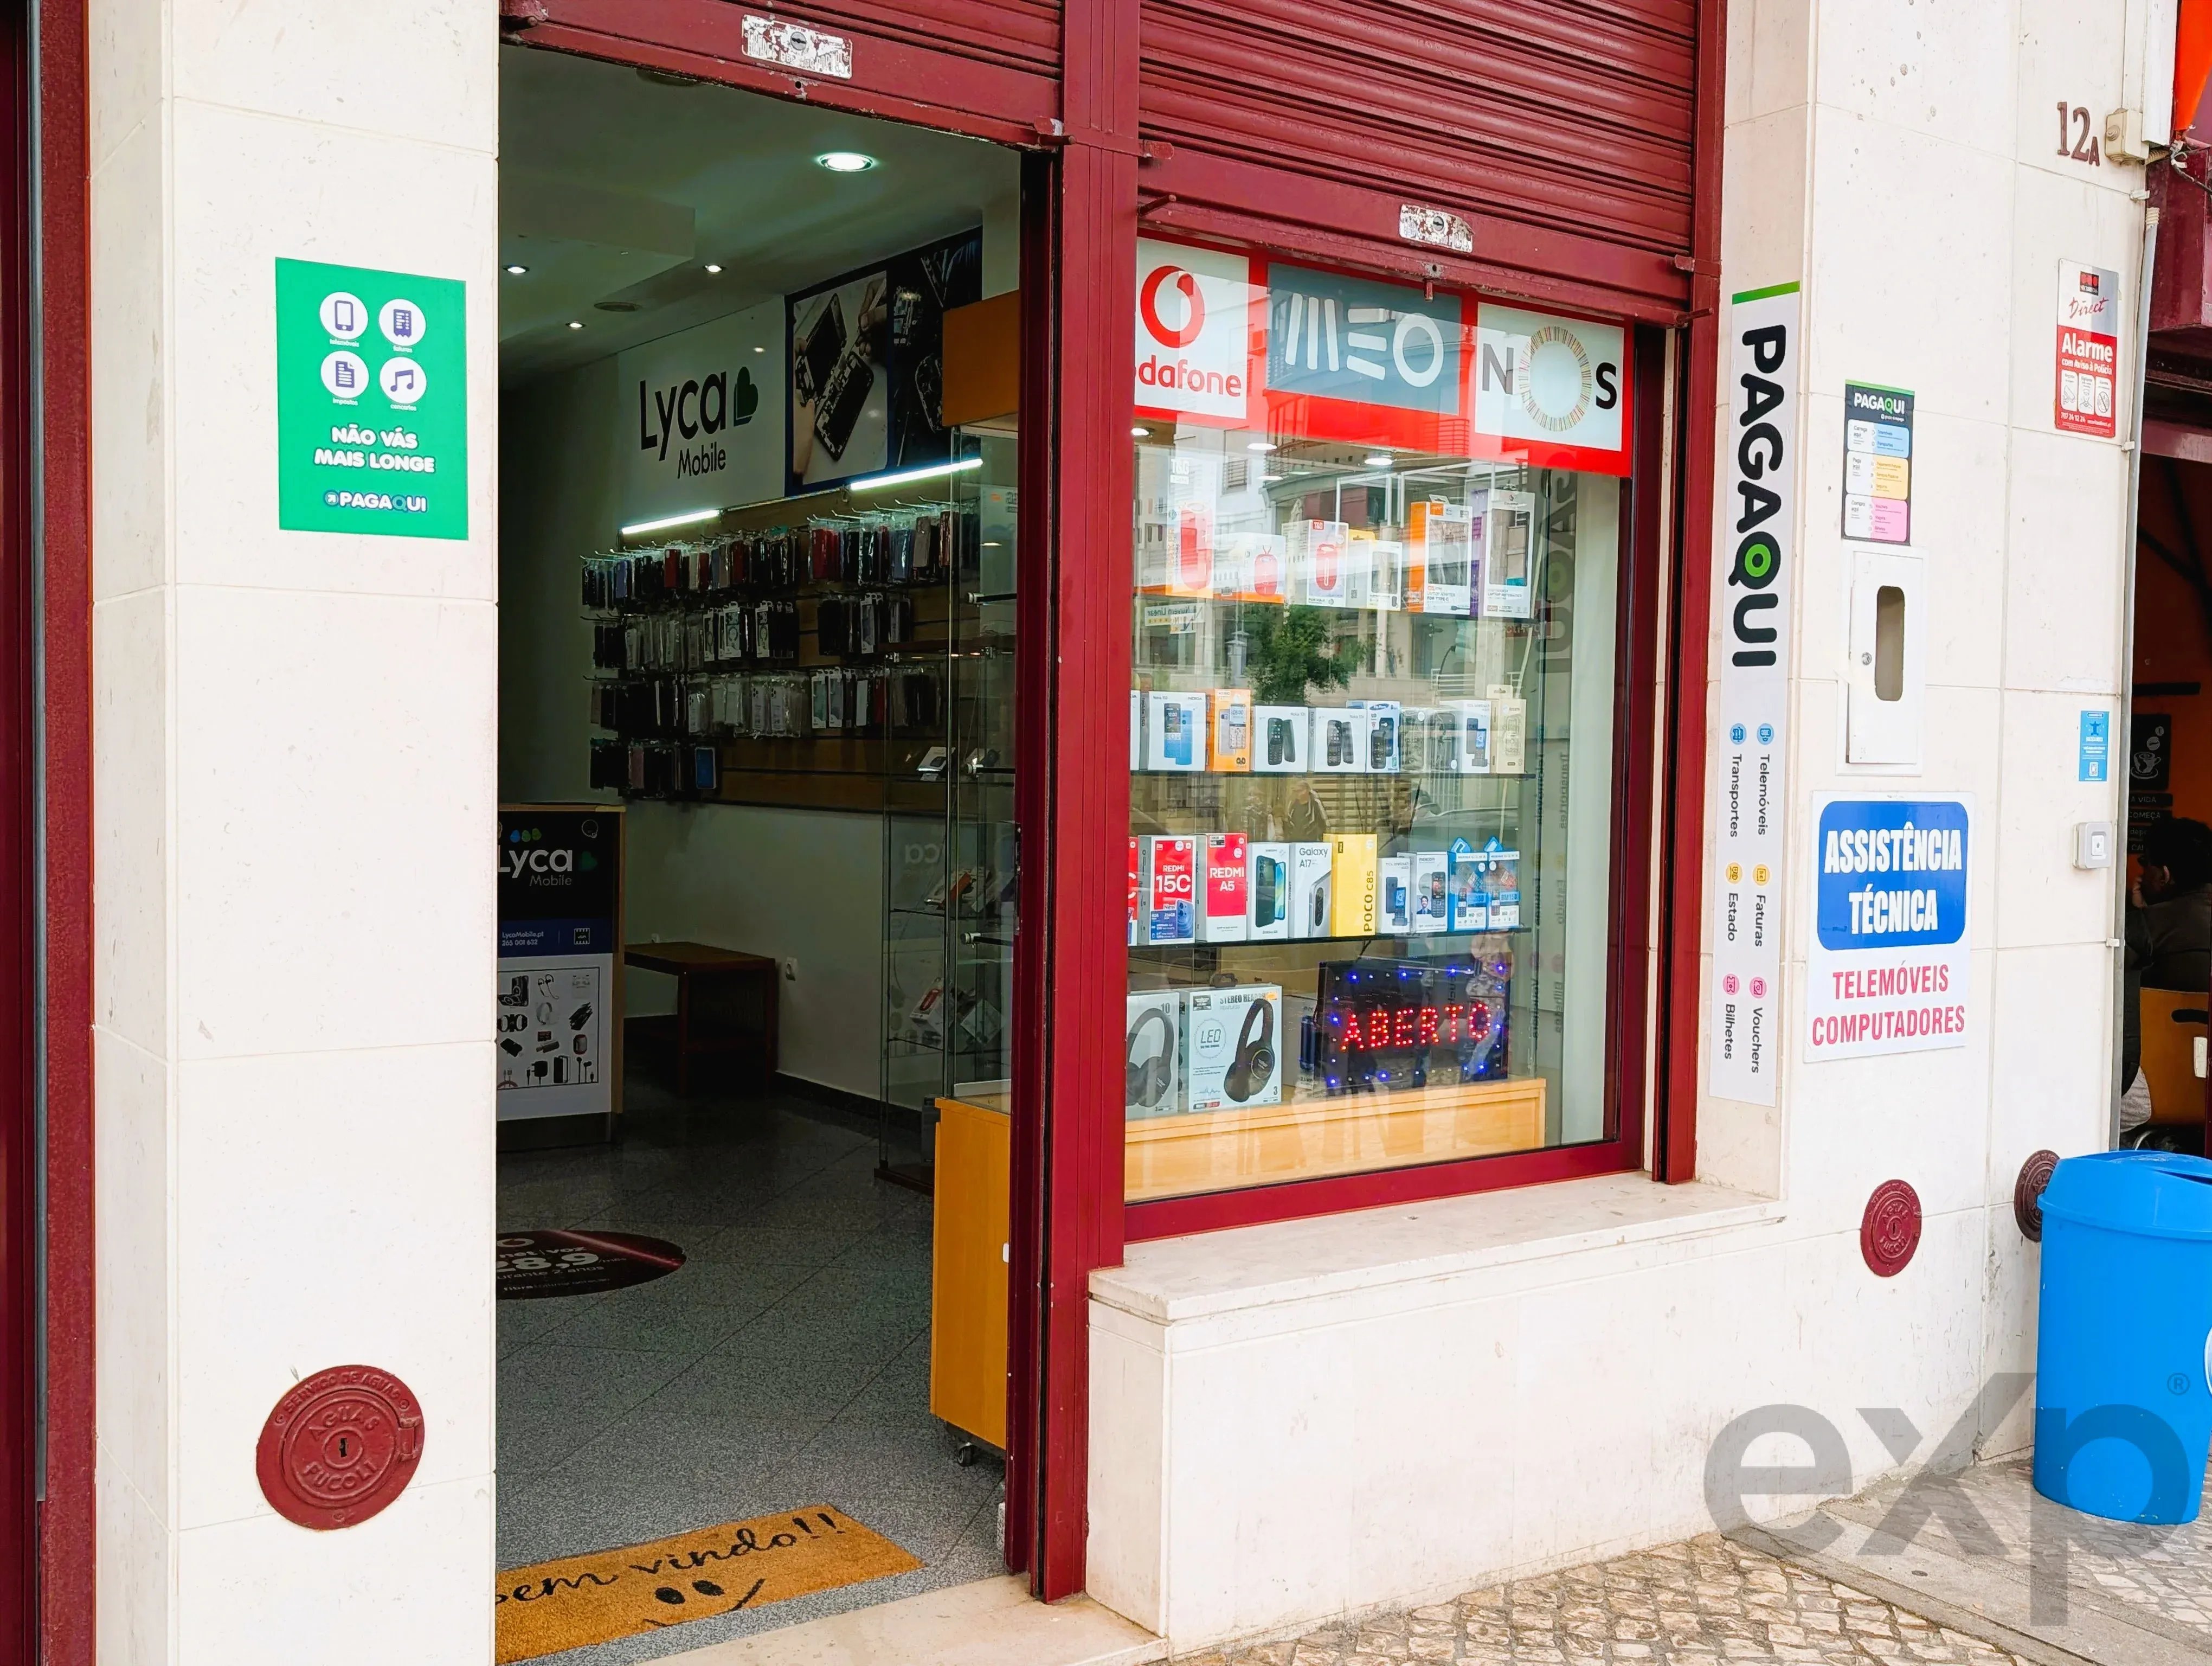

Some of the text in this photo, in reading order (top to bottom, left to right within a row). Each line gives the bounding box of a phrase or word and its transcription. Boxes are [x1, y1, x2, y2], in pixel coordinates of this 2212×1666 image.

[2069, 297, 2109, 319] Direct
[1285, 293, 1444, 387] MEO
[2062, 332, 2113, 363] Alarme
[1134, 355, 1242, 397] dafone
[1482, 326, 1617, 432] NOS
[2061, 358, 2074, 367] com
[640, 371, 726, 462] Lyca
[1854, 393, 1905, 414] PAGAQUI
[332, 424, 418, 449] NÃO VÁS
[314, 449, 435, 473] MAIS LONGE
[678, 441, 726, 479] Mobile
[339, 492, 427, 512] PAGAQUI
[1728, 324, 1786, 667] PAGAQUI
[1728, 754, 1742, 837] Transportes
[1758, 754, 1770, 836] Telemóveis
[498, 844, 573, 878] Lyca
[1300, 848, 1328, 857] Galaxy
[1300, 860, 1311, 868] A17
[1824, 821, 1962, 874] ASSISTÊNCIA
[530, 875, 572, 886] Mobile
[1155, 874, 1191, 893] 15C
[1162, 864, 1185, 873] REDMI
[1210, 867, 1244, 879] REDMI
[1219, 881, 1236, 892] A5
[1364, 894, 1373, 932] POCO
[1728, 892, 1738, 942] Estado
[1755, 894, 1766, 947] Faturas
[1849, 884, 1938, 934] TÉCNICA
[1833, 960, 1949, 999] TELEMÓVEIS
[1220, 995, 1242, 1004] STEREO
[1200, 1029, 1221, 1043] LED
[1340, 1002, 1491, 1051] ABERTO
[1724, 1003, 1735, 1060] Bilhetes
[1752, 1007, 1763, 1073] Vouchers
[1812, 1005, 1965, 1046] COMPUTADORES
[496, 1270, 548, 1280] urante
[629, 1513, 845, 1573] vindo!!
